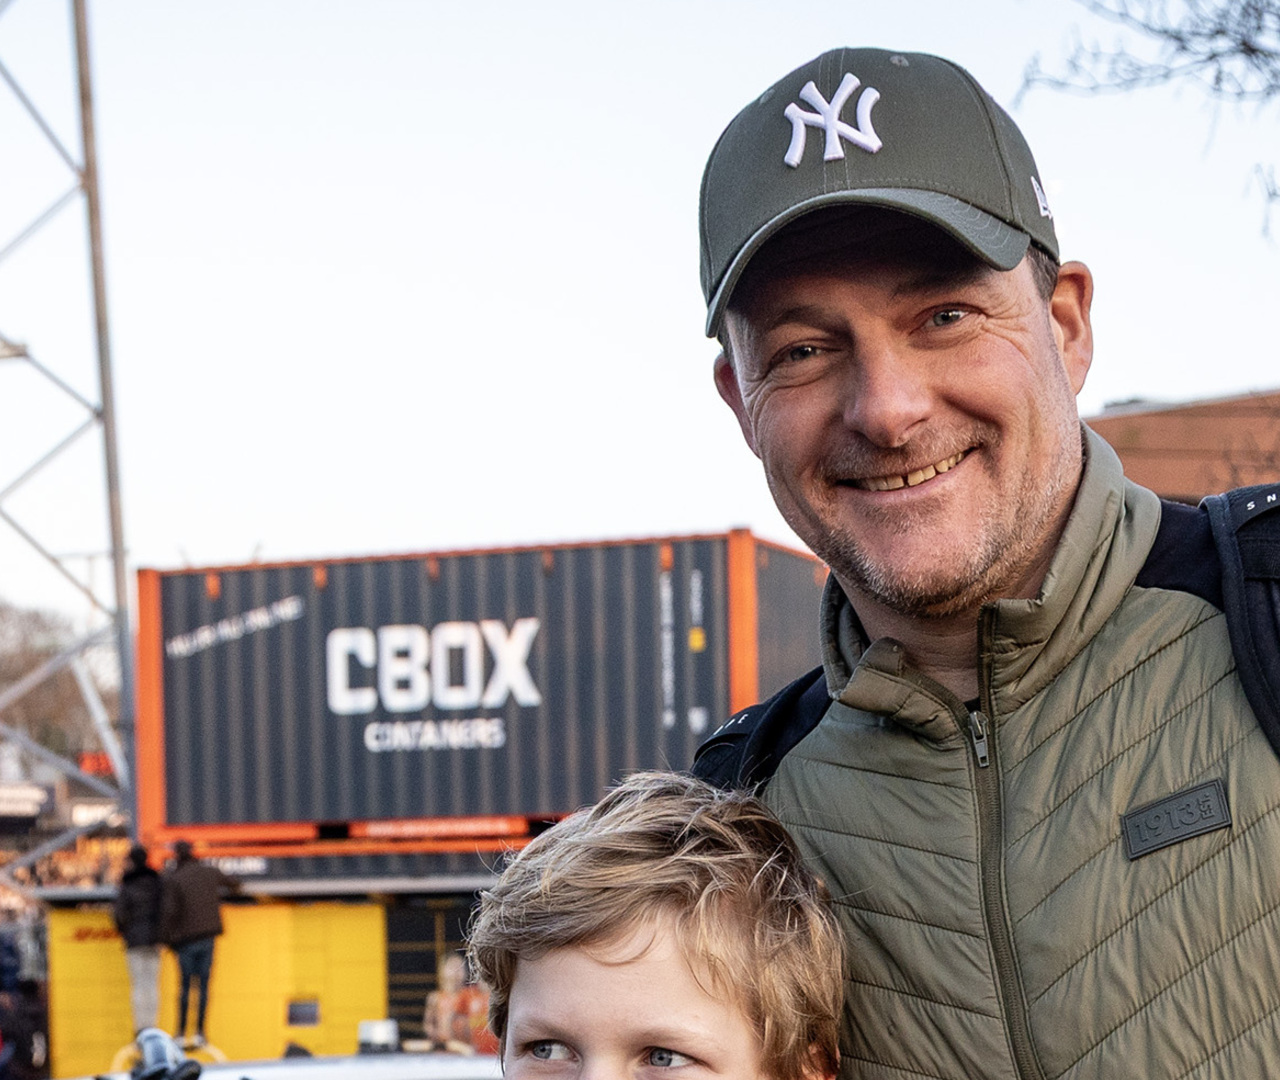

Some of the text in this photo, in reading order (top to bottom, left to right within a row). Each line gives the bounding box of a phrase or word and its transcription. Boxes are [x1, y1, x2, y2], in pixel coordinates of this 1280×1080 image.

[783, 72, 884, 169] NY
[325, 616, 542, 716] CBOX
[1134, 802, 1202, 843] 1913
